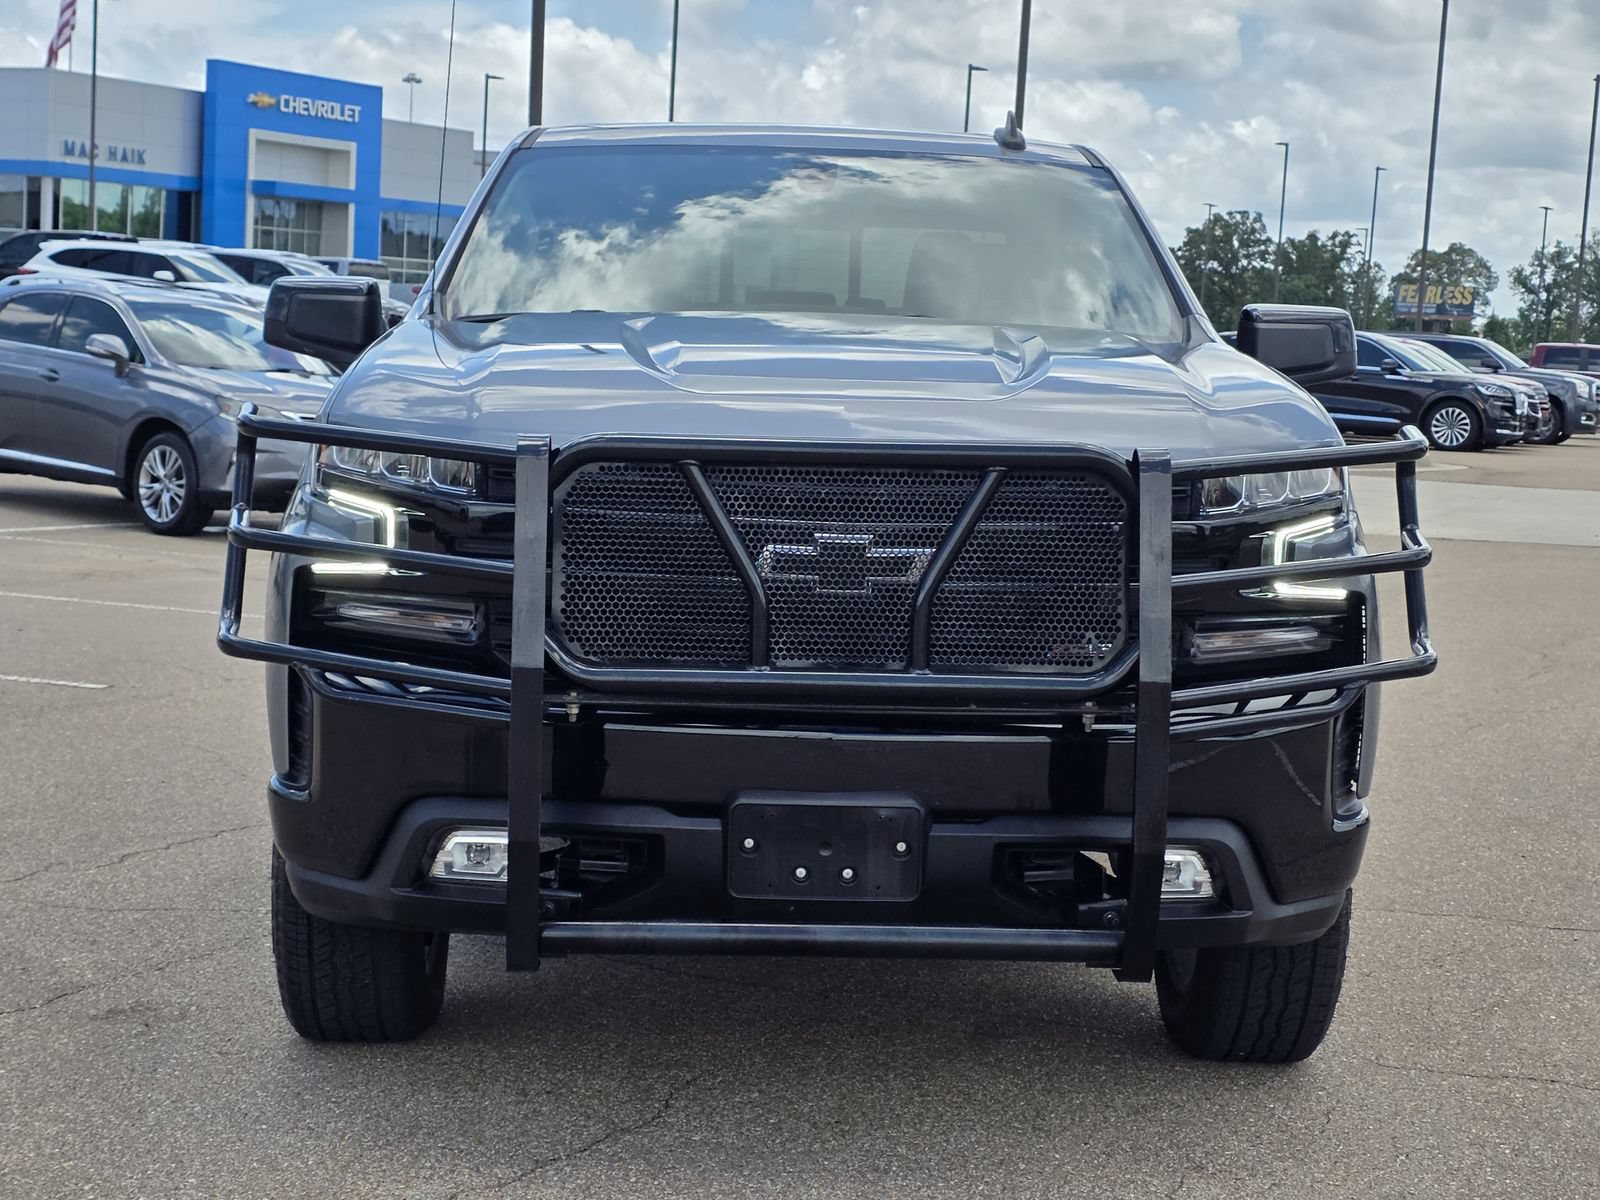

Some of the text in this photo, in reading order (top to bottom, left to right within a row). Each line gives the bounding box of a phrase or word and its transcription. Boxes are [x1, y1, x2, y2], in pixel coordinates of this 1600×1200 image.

[280, 94, 361, 123] CHEVROLET
[107, 145, 146, 165] HAIK
[1397, 284, 1474, 305] FERLESS
